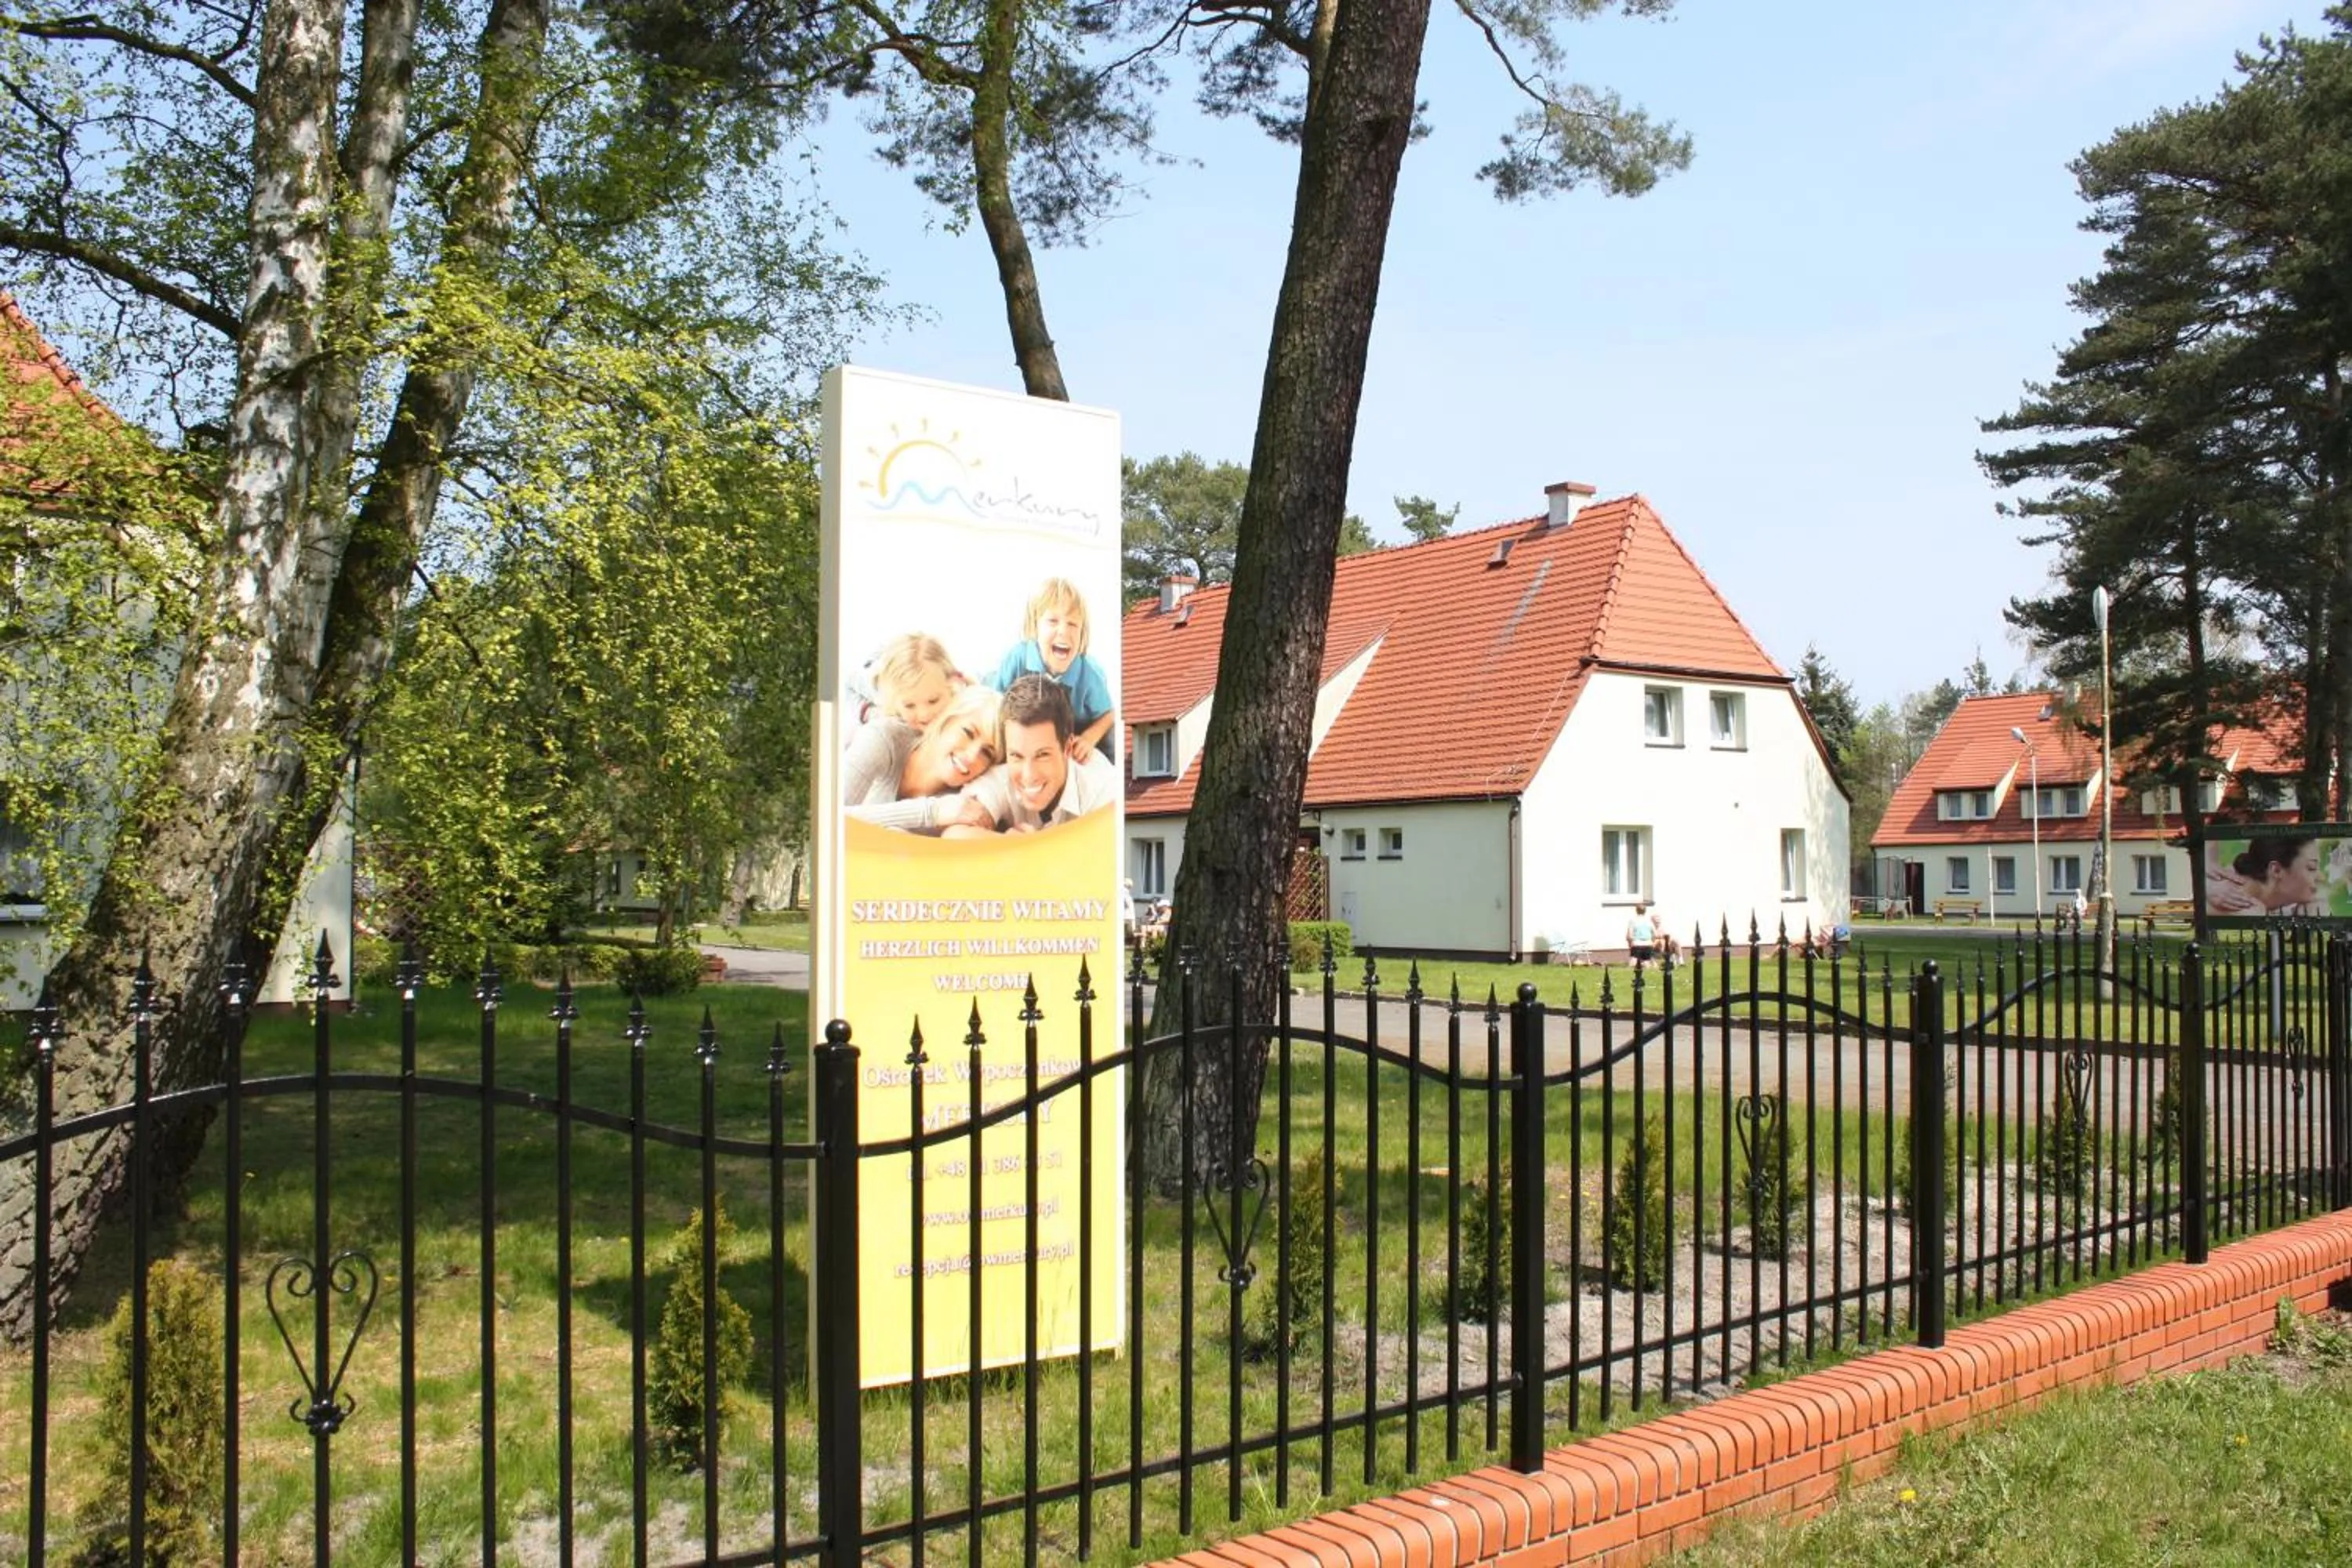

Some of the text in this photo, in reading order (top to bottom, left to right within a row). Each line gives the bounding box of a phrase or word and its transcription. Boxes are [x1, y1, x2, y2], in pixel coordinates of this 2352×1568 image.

[852, 899, 1108, 923] SERDECZNIE WITAMY
[861, 937, 1099, 958] HERZLICH WILLKOMMEN
[933, 973, 1030, 993] WELCOME
[864, 1063, 946, 1087] Ośroek
